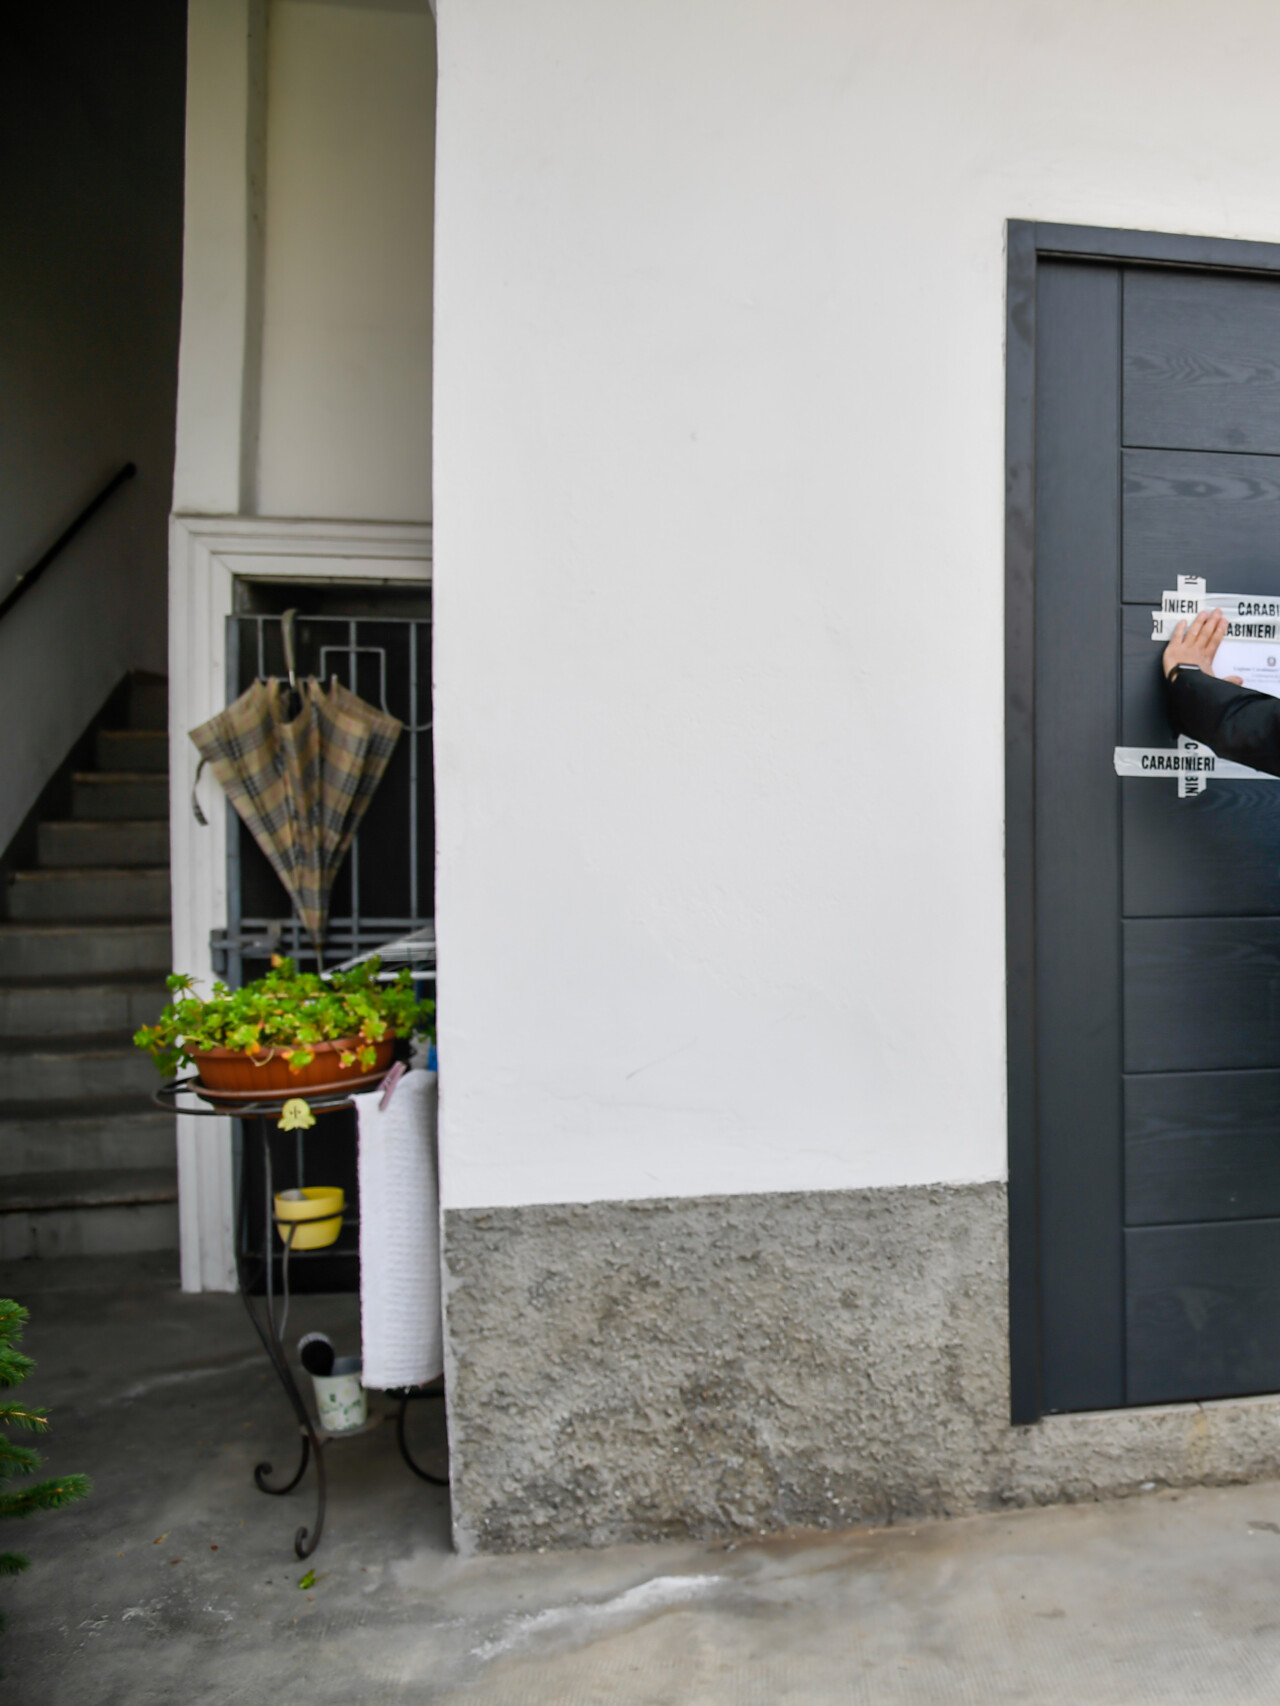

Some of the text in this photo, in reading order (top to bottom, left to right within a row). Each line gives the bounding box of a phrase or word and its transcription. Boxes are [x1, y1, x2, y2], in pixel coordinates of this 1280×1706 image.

[1164, 598, 1198, 613] INIERI
[1224, 622, 1276, 639] ABINIERI
[1141, 754, 1215, 771] CARABINIERI
